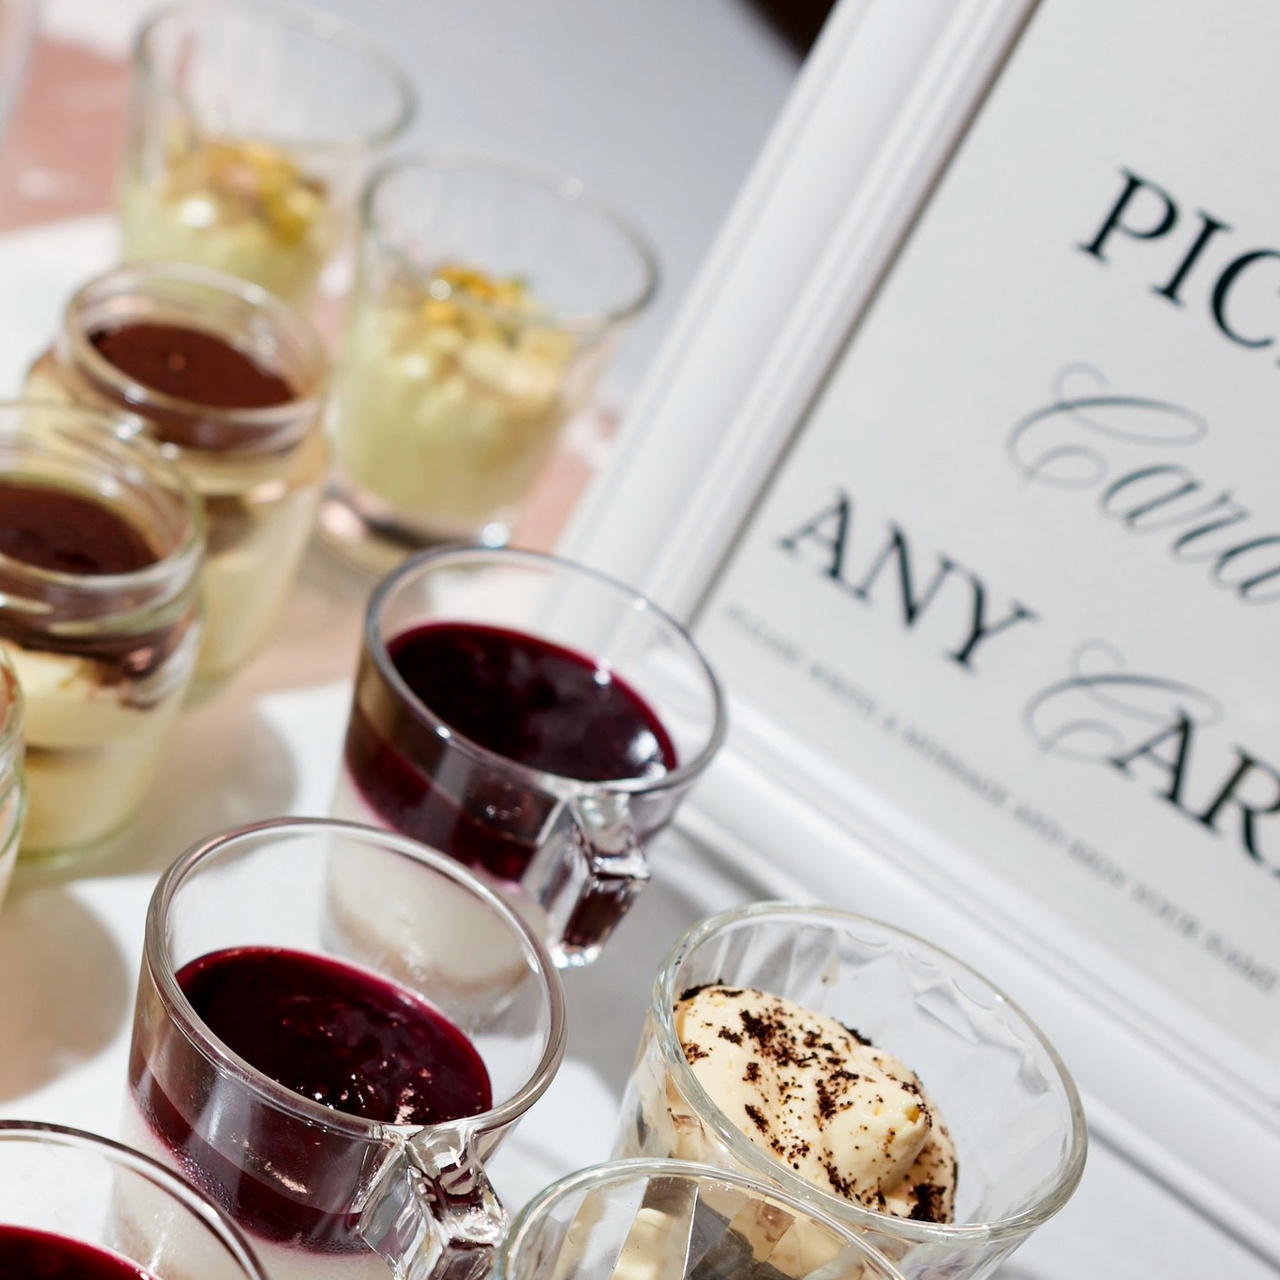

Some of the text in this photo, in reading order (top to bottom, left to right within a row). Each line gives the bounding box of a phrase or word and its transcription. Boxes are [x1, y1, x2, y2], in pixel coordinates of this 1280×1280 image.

[1074, 165, 1280, 370] PIC
[776, 486, 1280, 880] ANY CAR
